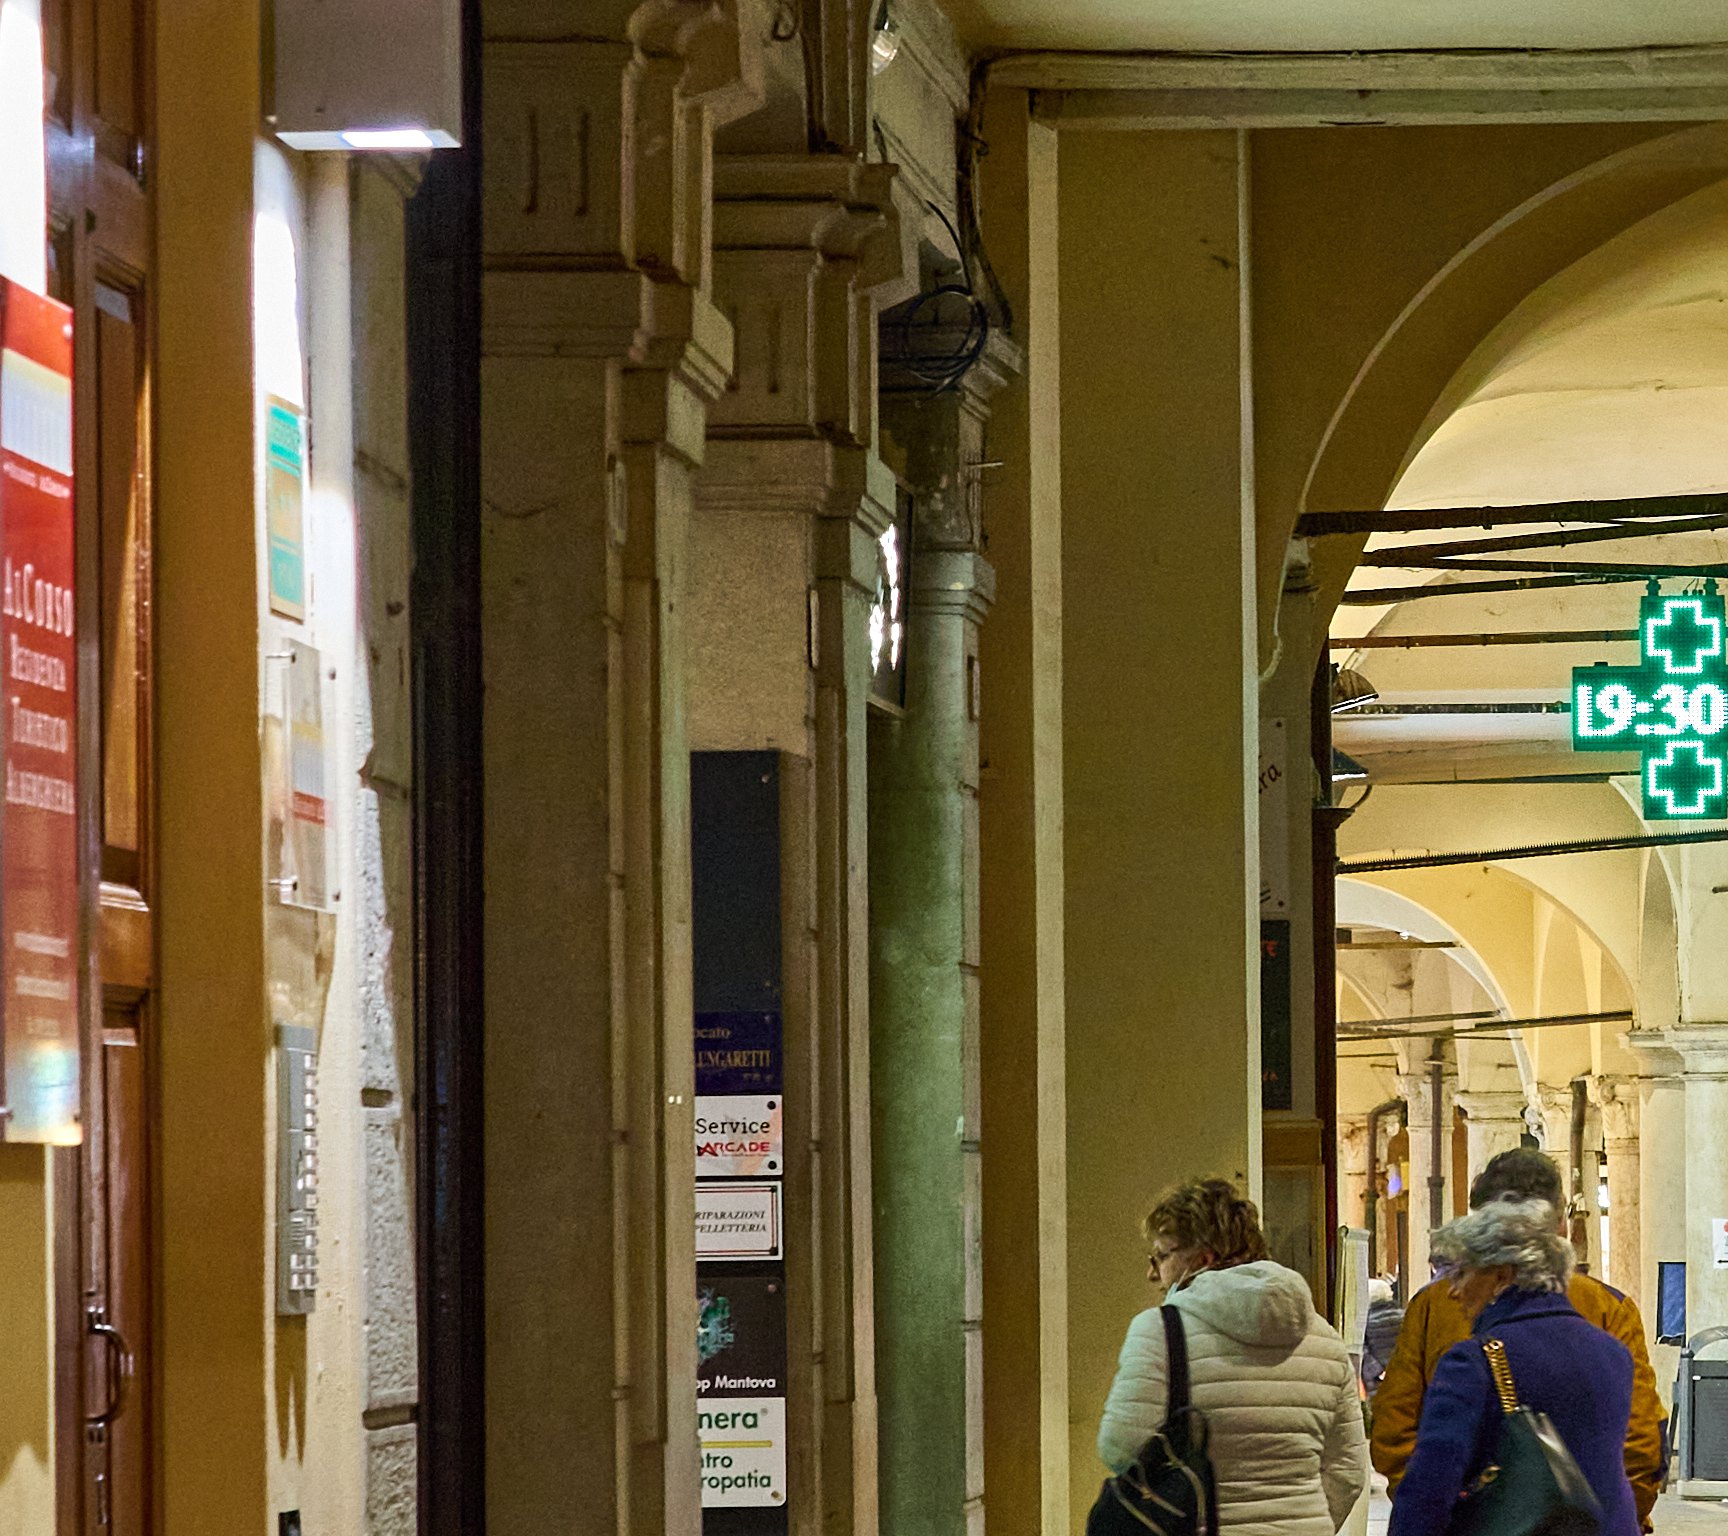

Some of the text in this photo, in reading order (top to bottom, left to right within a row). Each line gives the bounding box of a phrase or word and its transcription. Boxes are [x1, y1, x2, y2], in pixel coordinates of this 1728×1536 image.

[695, 1117, 770, 1134] Service
[697, 1141, 770, 1157] ARCADE
[695, 1210, 765, 1220] RIPARAZIONI
[714, 1374, 776, 1389] Mantova
[698, 1412, 758, 1429] nera
